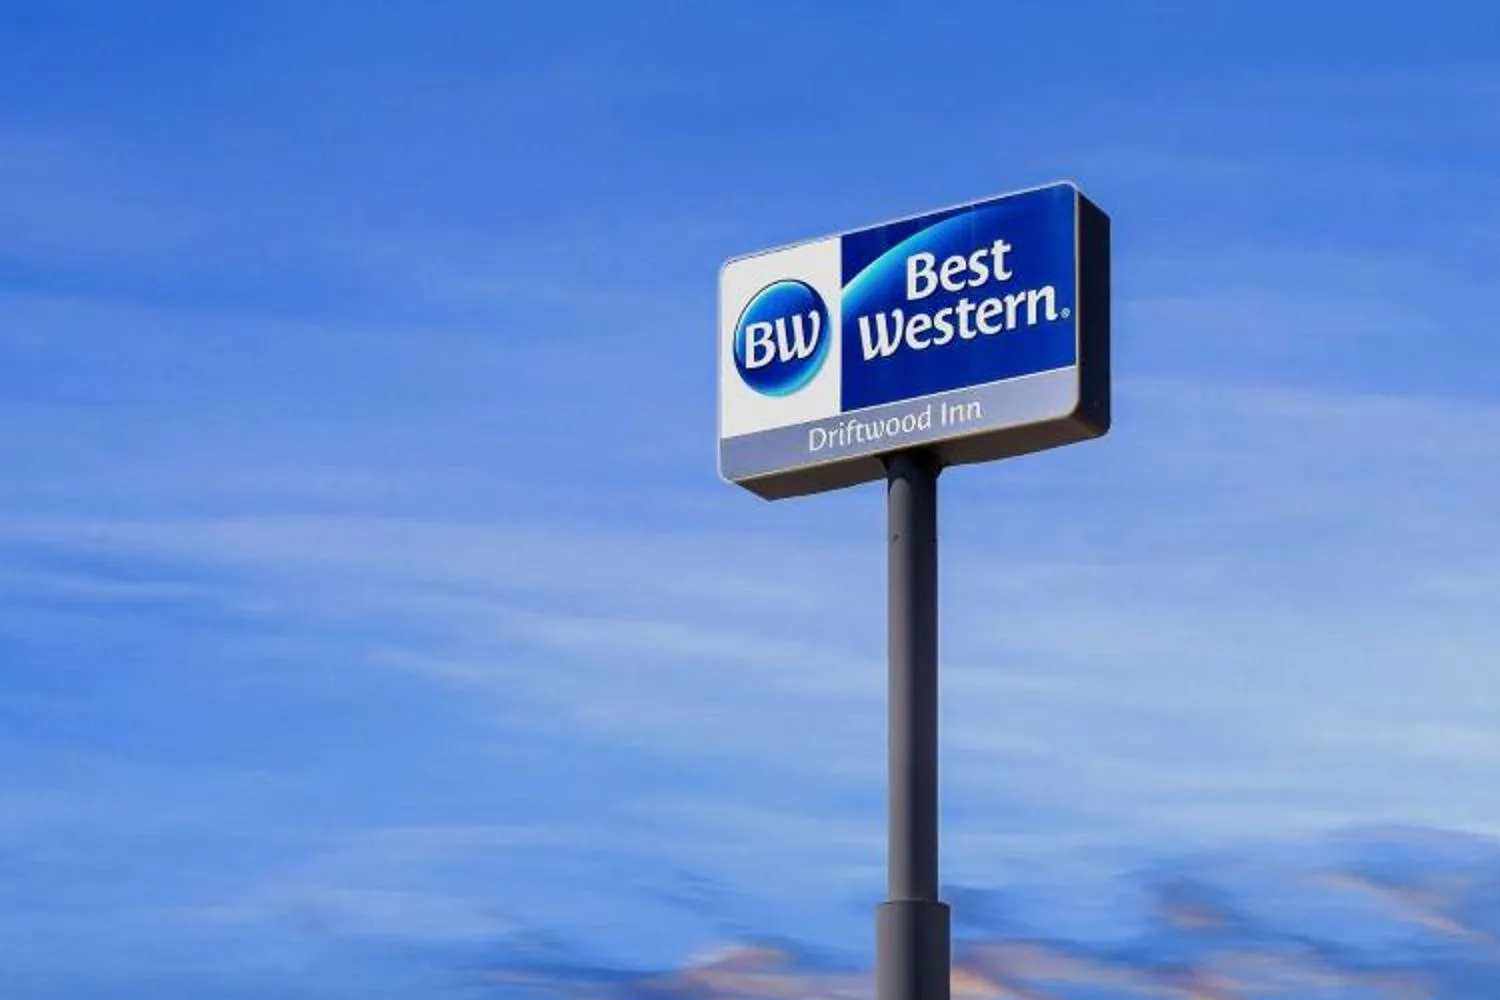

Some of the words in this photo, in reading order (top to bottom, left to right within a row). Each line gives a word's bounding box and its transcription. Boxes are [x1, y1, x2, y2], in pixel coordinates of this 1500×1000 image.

[907, 239, 1013, 301] Best
[745, 310, 821, 369] BW
[858, 285, 1058, 361] Western
[808, 405, 931, 451] Driftwood
[941, 401, 983, 426] Inn
